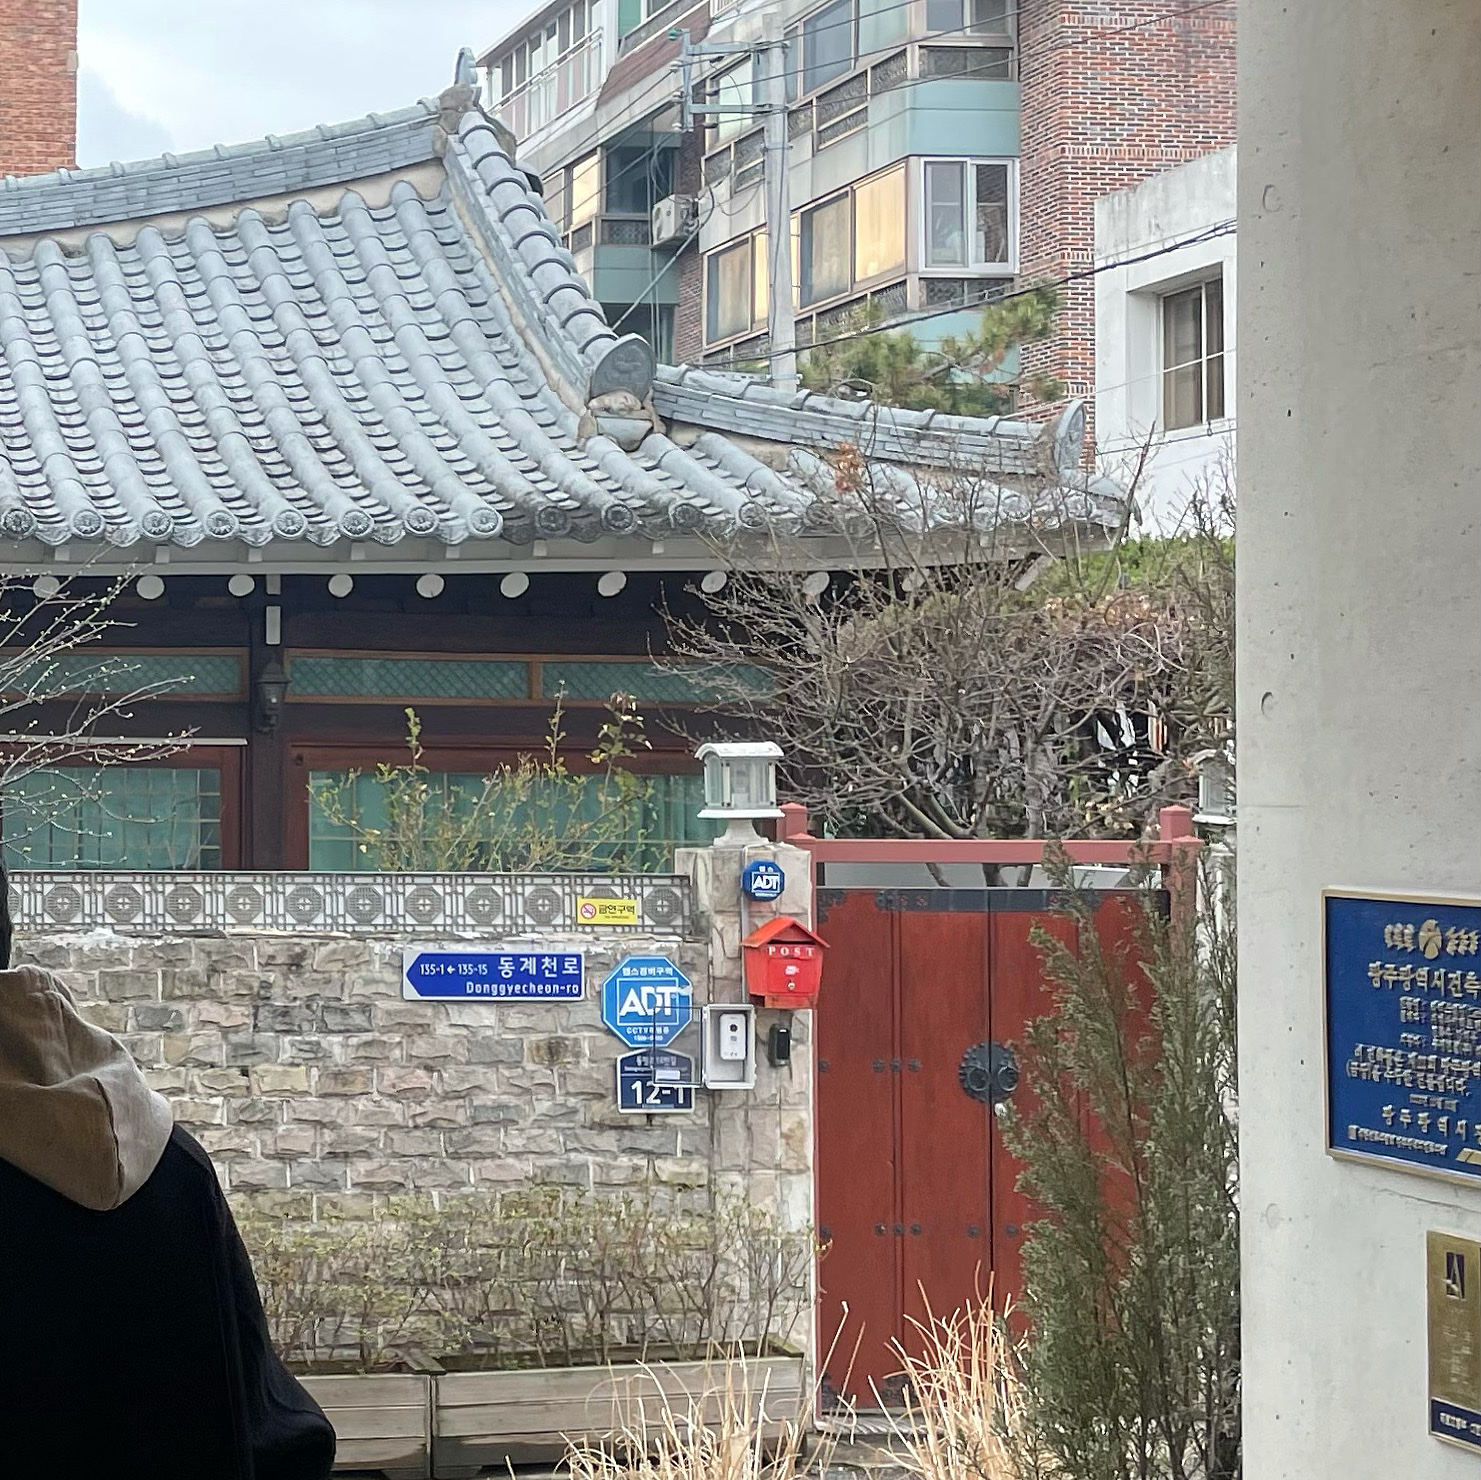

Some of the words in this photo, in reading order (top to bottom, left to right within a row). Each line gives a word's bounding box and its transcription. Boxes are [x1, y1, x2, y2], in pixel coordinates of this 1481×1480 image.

[752, 875, 779, 890] ADT
[768, 946, 815, 957] POST
[498, 956, 580, 979] 동계천로
[466, 981, 579, 996] Donggyecheon-ro
[619, 985, 675, 1017] ADT
[630, 1080, 685, 1105] 12-1
